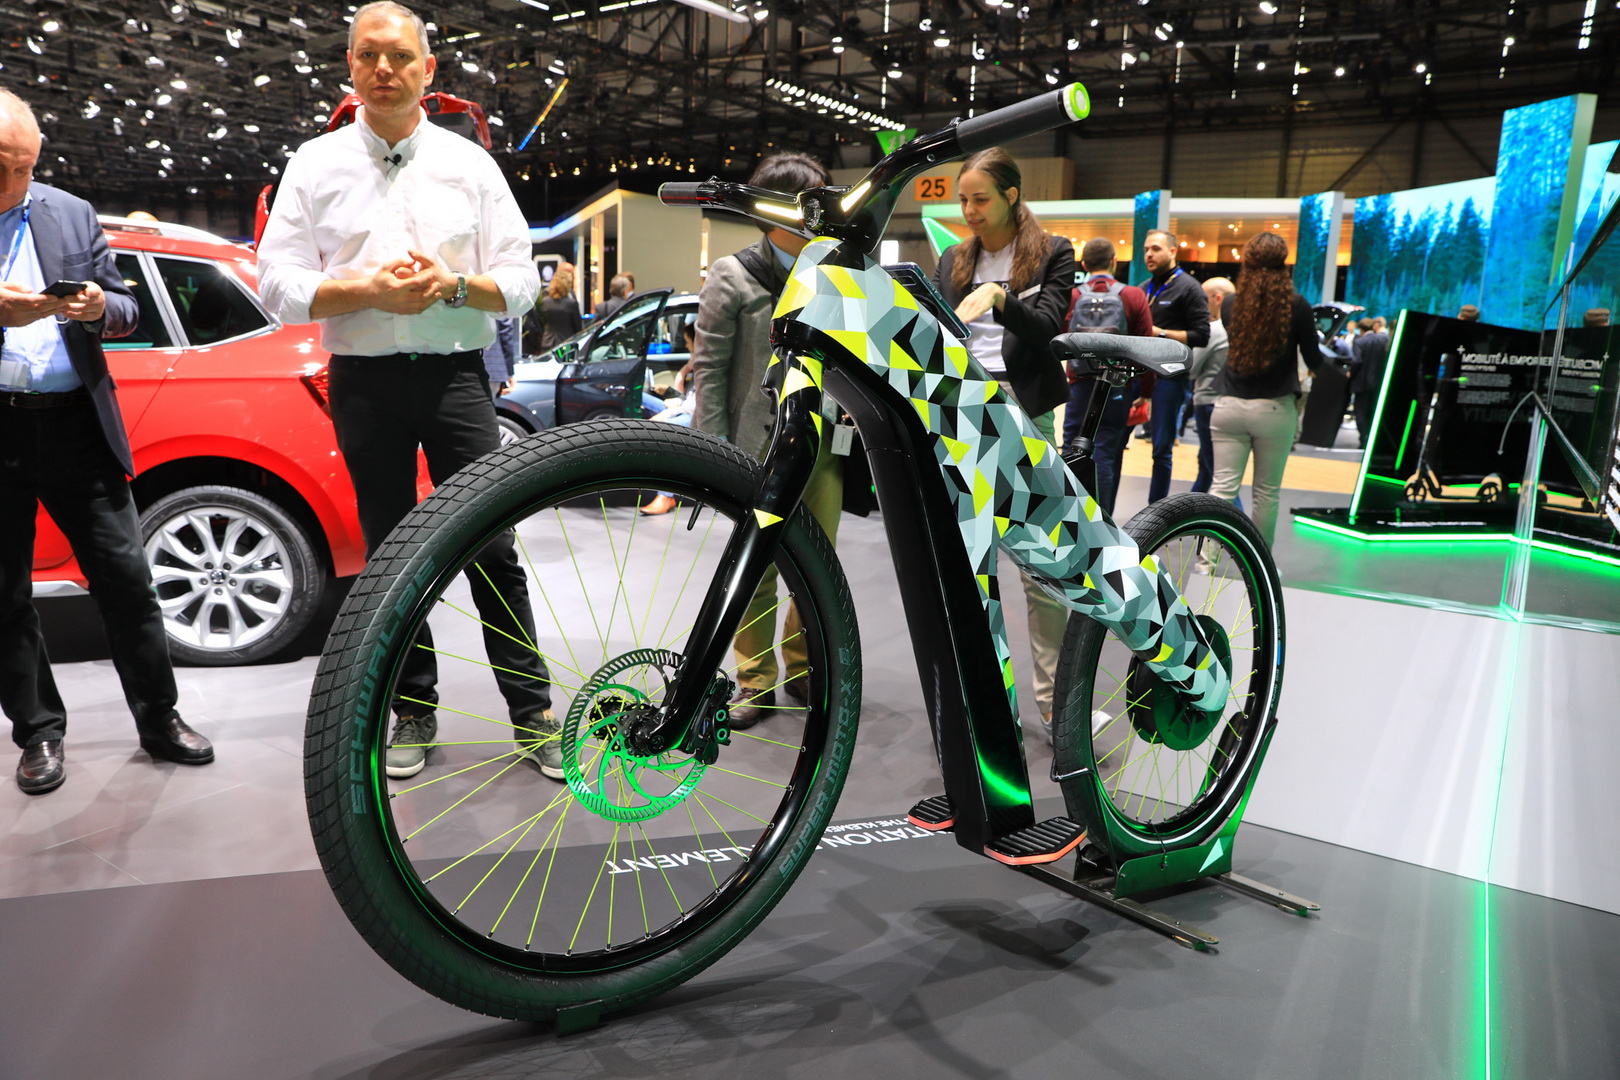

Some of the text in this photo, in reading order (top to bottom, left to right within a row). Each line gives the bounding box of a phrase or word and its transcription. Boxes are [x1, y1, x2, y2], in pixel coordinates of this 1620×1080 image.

[921, 179, 946, 198] 25
[1461, 353, 1501, 364] MOBILITÉ
[350, 555, 436, 814] SCHWALBE
[779, 678, 852, 878] SUPER MOTO-X
[877, 818, 908, 828] THE
